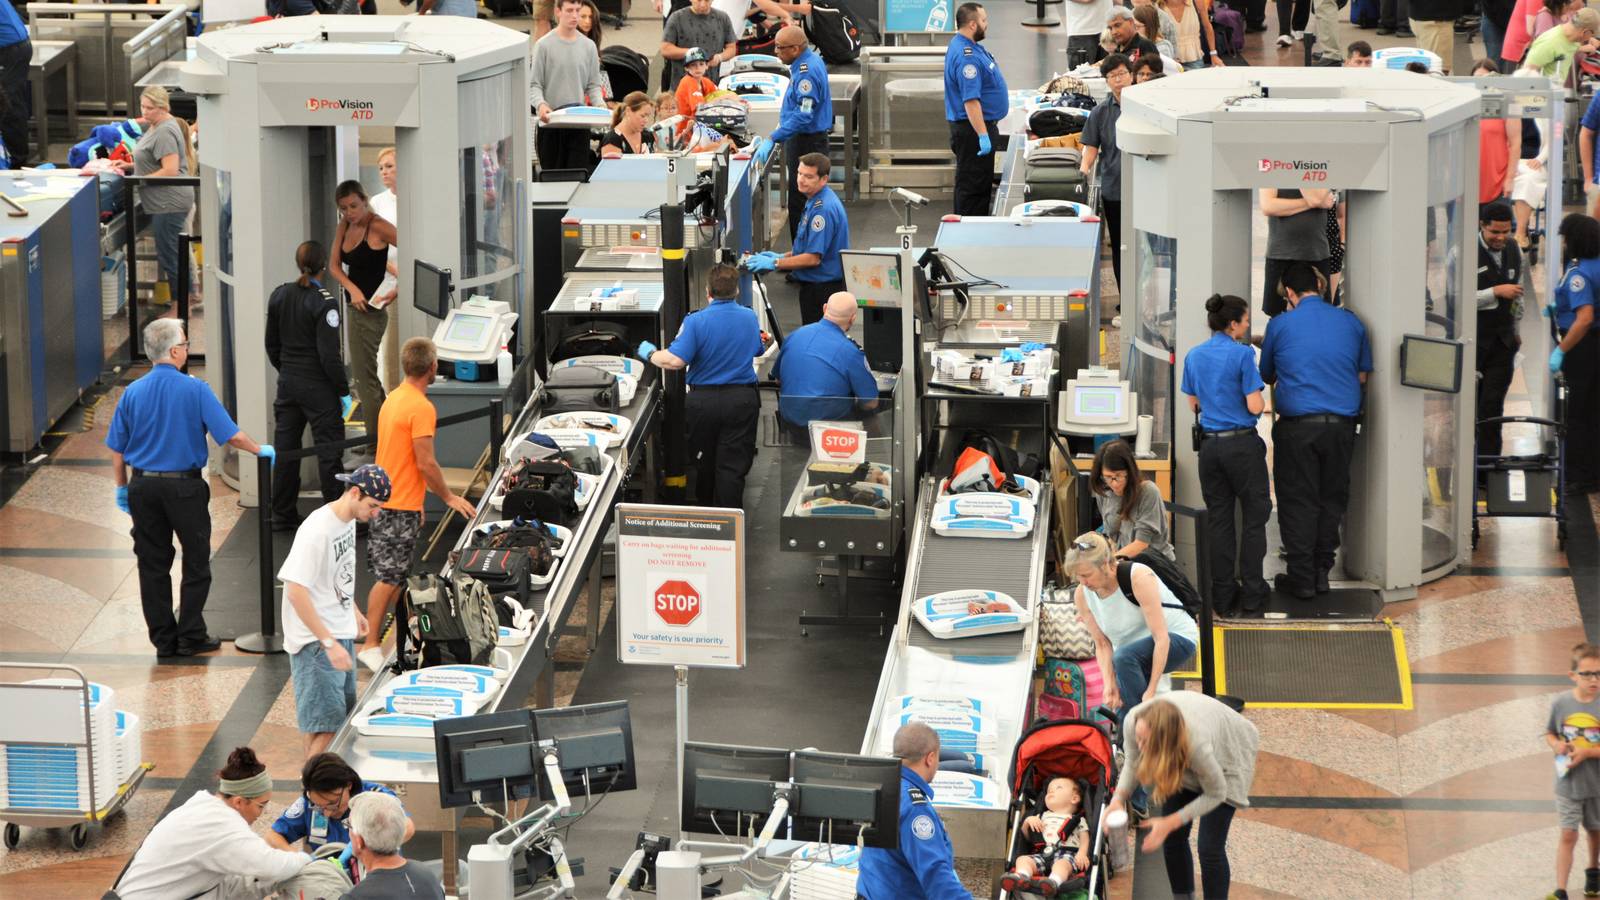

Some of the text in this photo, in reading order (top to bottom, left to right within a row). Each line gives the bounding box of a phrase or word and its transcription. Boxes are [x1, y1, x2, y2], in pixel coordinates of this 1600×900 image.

[320, 99, 374, 110] ProVision
[351, 110, 374, 120] ATD
[668, 159, 675, 173] 5
[1273, 160, 1328, 171] ProVision
[1302, 171, 1327, 181] ATD
[902, 235, 910, 250] 6
[825, 435, 856, 447] STOP
[625, 518, 646, 526] Notice
[655, 520, 689, 529] Additional
[690, 521, 721, 531] Screening
[622, 541, 640, 549] Carry
[650, 541, 665, 550] bags
[666, 542, 689, 551] waiting
[689, 543, 699, 551] for
[700, 544, 732, 552] additional
[662, 552, 692, 560] screening
[657, 593, 698, 612] STOP
[632, 633, 724, 646] Your safety is our priority
